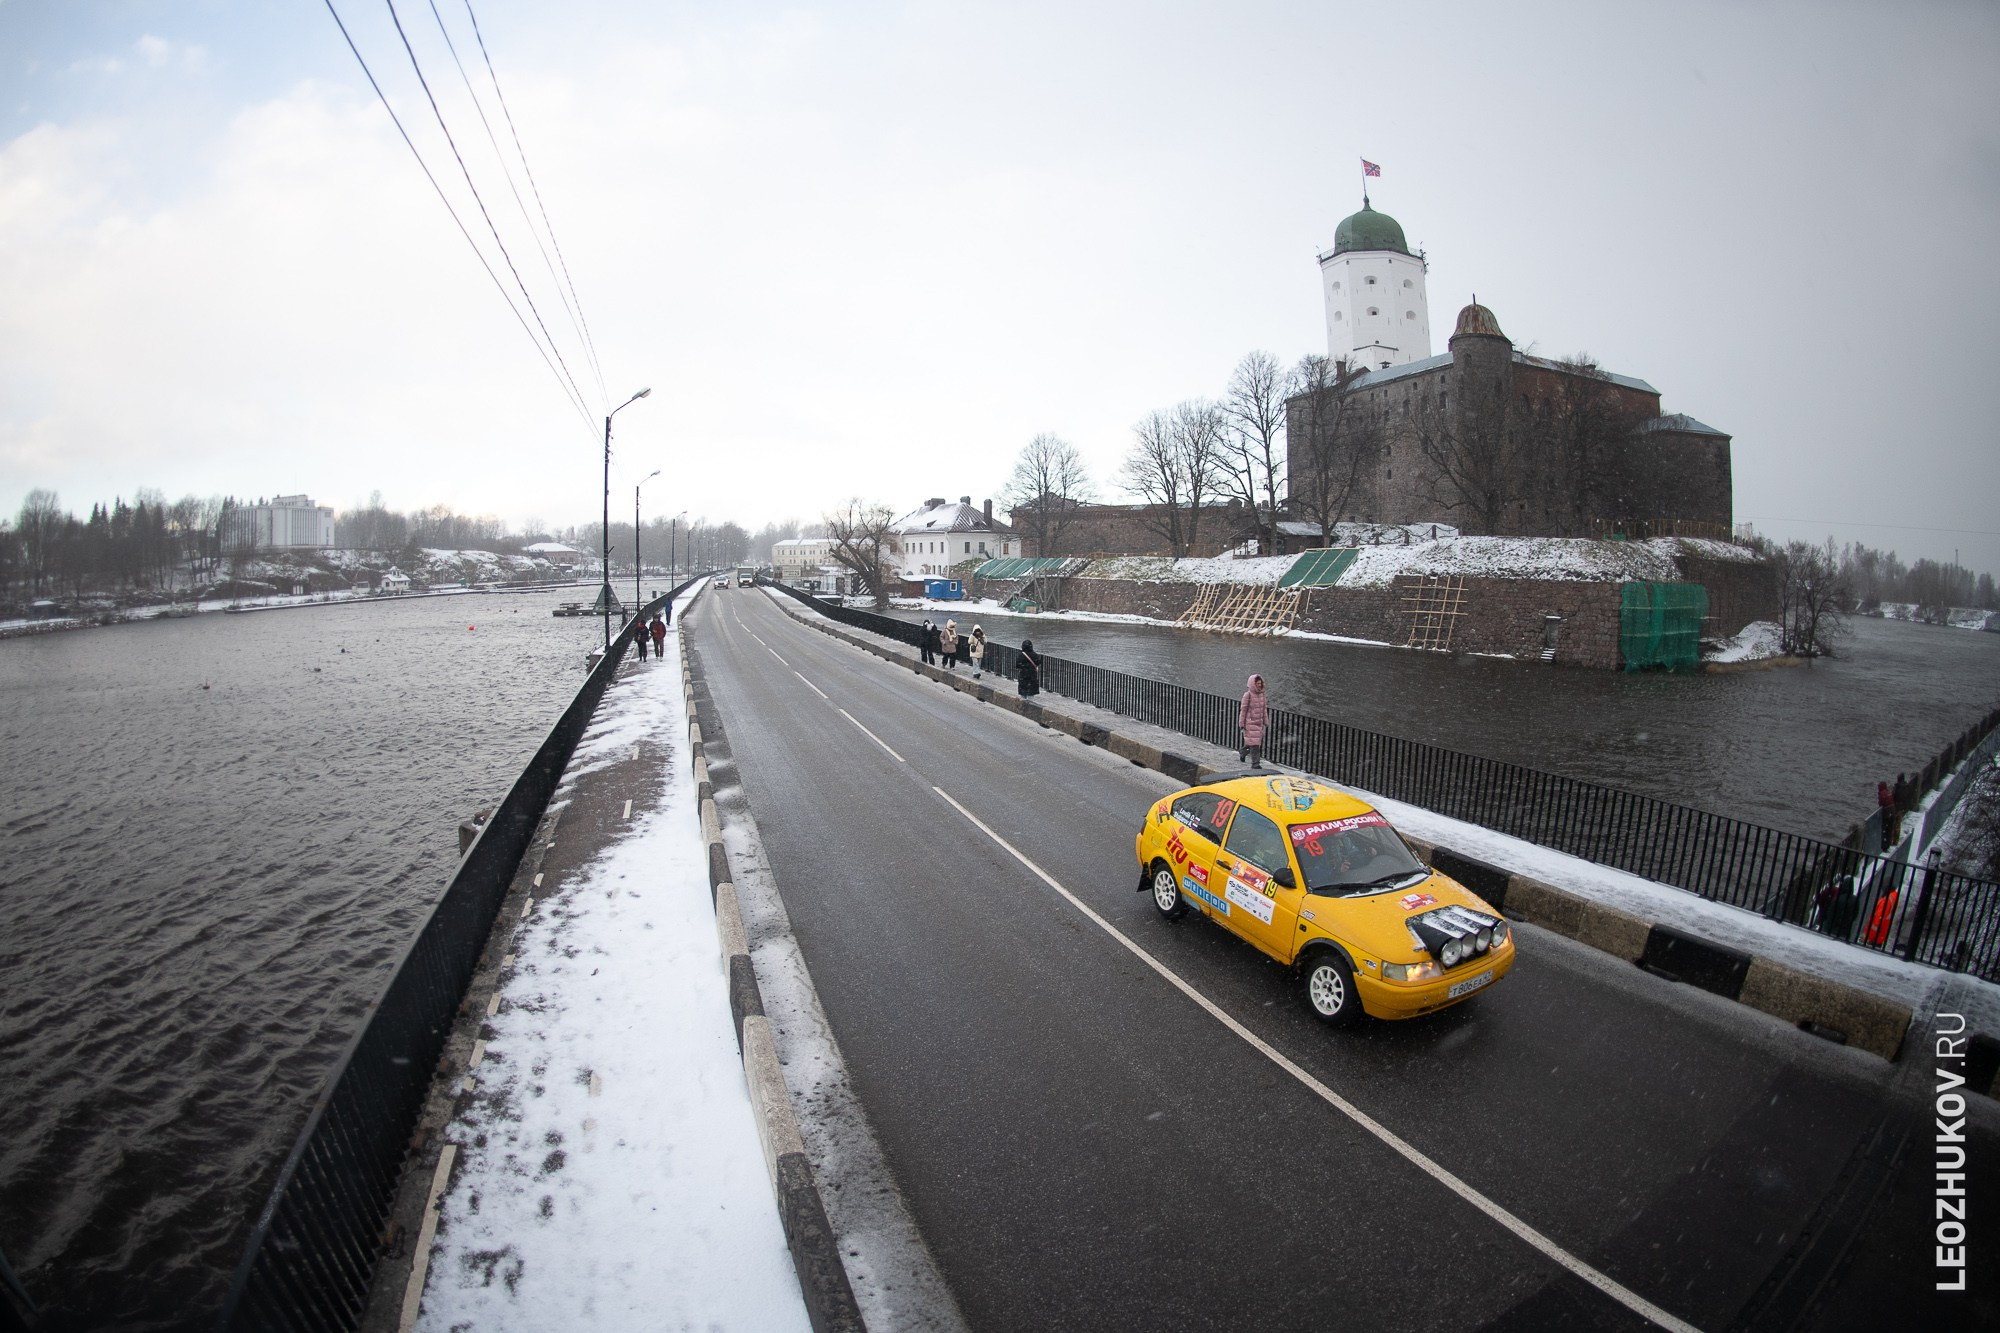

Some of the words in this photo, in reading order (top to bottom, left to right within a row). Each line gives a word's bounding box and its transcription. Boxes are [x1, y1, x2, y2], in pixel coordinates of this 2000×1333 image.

[1211, 799, 1233, 828] 19
[1306, 820, 1343, 835] РАЛЛИ
[1343, 816, 1378, 825] РОССИИ
[1304, 840, 1324, 857] 19
[1254, 879, 1264, 889] 24
[1265, 878, 1278, 897] 19
